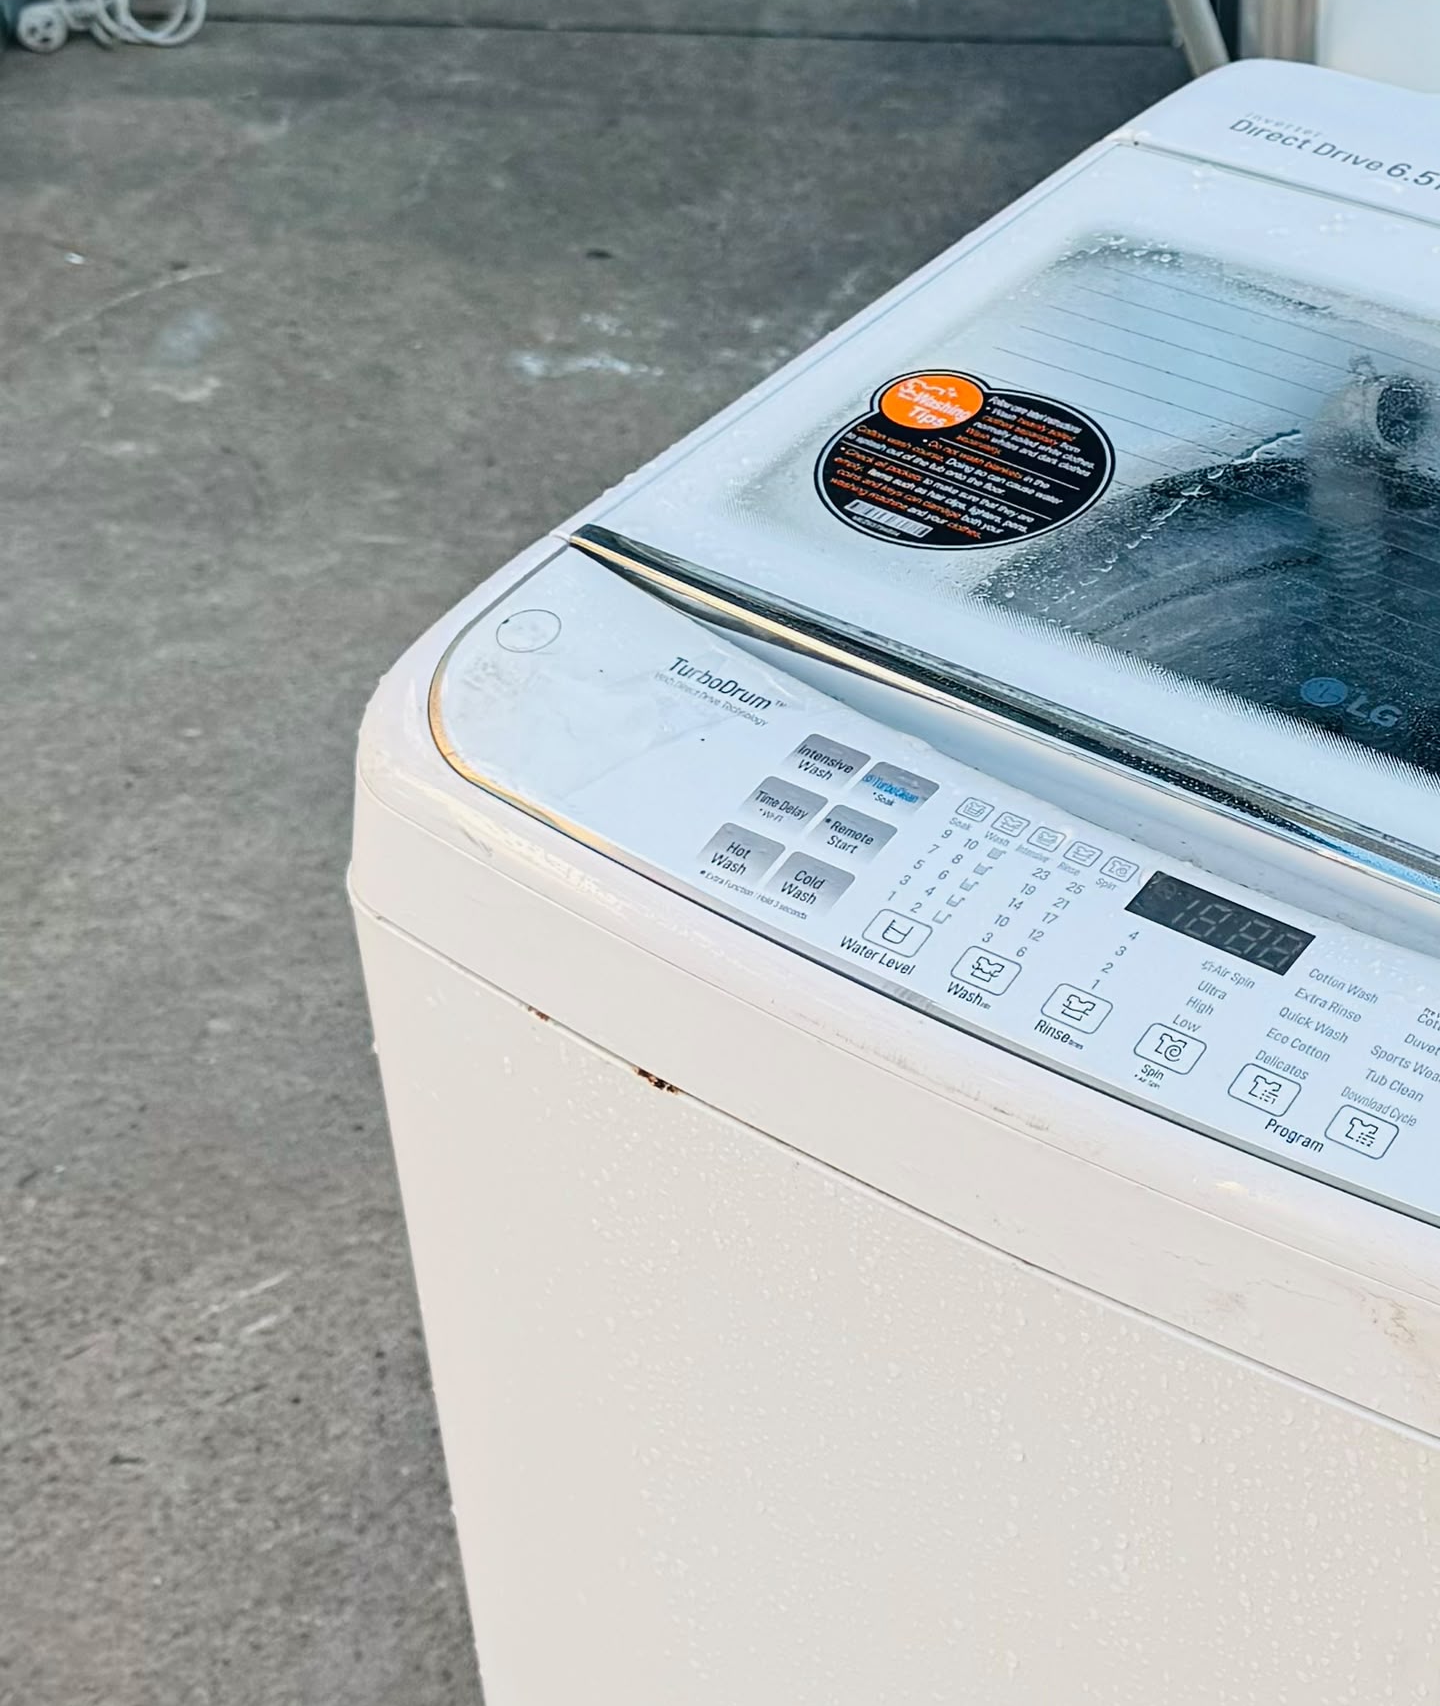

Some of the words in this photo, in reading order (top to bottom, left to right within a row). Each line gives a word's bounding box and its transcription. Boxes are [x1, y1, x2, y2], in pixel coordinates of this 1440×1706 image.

[1229, 119, 1311, 150] Direct
[1312, 142, 1385, 172] Drive
[1346, 694, 1403, 728] LG
[797, 744, 854, 774] Intensive
[797, 759, 833, 781] Wash
[755, 790, 780, 808] Time
[778, 799, 809, 821] Delay
[830, 820, 874, 845] Remote
[941, 829, 953, 839] 9
[725, 840, 752, 861] Hot
[827, 835, 858, 854] Start
[927, 843, 940, 854] 7
[963, 838, 979, 851] 10
[711, 853, 747, 877] Wash
[913, 859, 926, 870] 5
[951, 854, 964, 865] 8
[794, 870, 826, 890] Cold
[899, 874, 912, 885] 3
[937, 869, 950, 880] 6
[1031, 867, 1051, 881] 23
[780, 881, 817, 905] Wash
[924, 886, 937, 897] 4
[1020, 882, 1037, 896] 19
[1065, 881, 1086, 895] 25
[909, 901, 923, 914] 2
[1007, 897, 1025, 911] 14
[1052, 897, 1071, 911] 21
[994, 914, 1010, 927] 10
[1041, 911, 1059, 926] 17
[982, 931, 994, 944] 3
[1027, 928, 1046, 943] 12
[1128, 930, 1140, 942] 4
[840, 934, 880, 961] Water
[878, 950, 916, 976] Level
[1016, 946, 1028, 959] 6
[1114, 945, 1127, 958] 3
[1101, 962, 1114, 974] 2
[1197, 980, 1228, 1000] Ultra
[1230, 973, 1256, 990] Spin
[1308, 968, 1346, 991] Cotton
[1346, 983, 1379, 1005] Wash
[946, 980, 983, 1006] Wash
[1185, 995, 1214, 1016] High
[1294, 987, 1328, 1009] Extra
[1327, 1001, 1362, 1023] Rinse
[1033, 1019, 1071, 1044] Rinse
[1172, 1013, 1202, 1033] Low
[1279, 1006, 1314, 1029] Quick
[1314, 1021, 1349, 1044] Wash
[1266, 1027, 1289, 1045] Eco
[1290, 1038, 1331, 1063] Cotton
[1255, 1049, 1309, 1081] Delicates
[1370, 1045, 1412, 1070] Sports
[1140, 1063, 1165, 1081] Spin
[1365, 1068, 1388, 1086] Tub
[1389, 1079, 1424, 1102] Clean
[1341, 1086, 1392, 1115] Download
[1389, 1107, 1418, 1127] Cycle
[1264, 1118, 1325, 1154] Program
